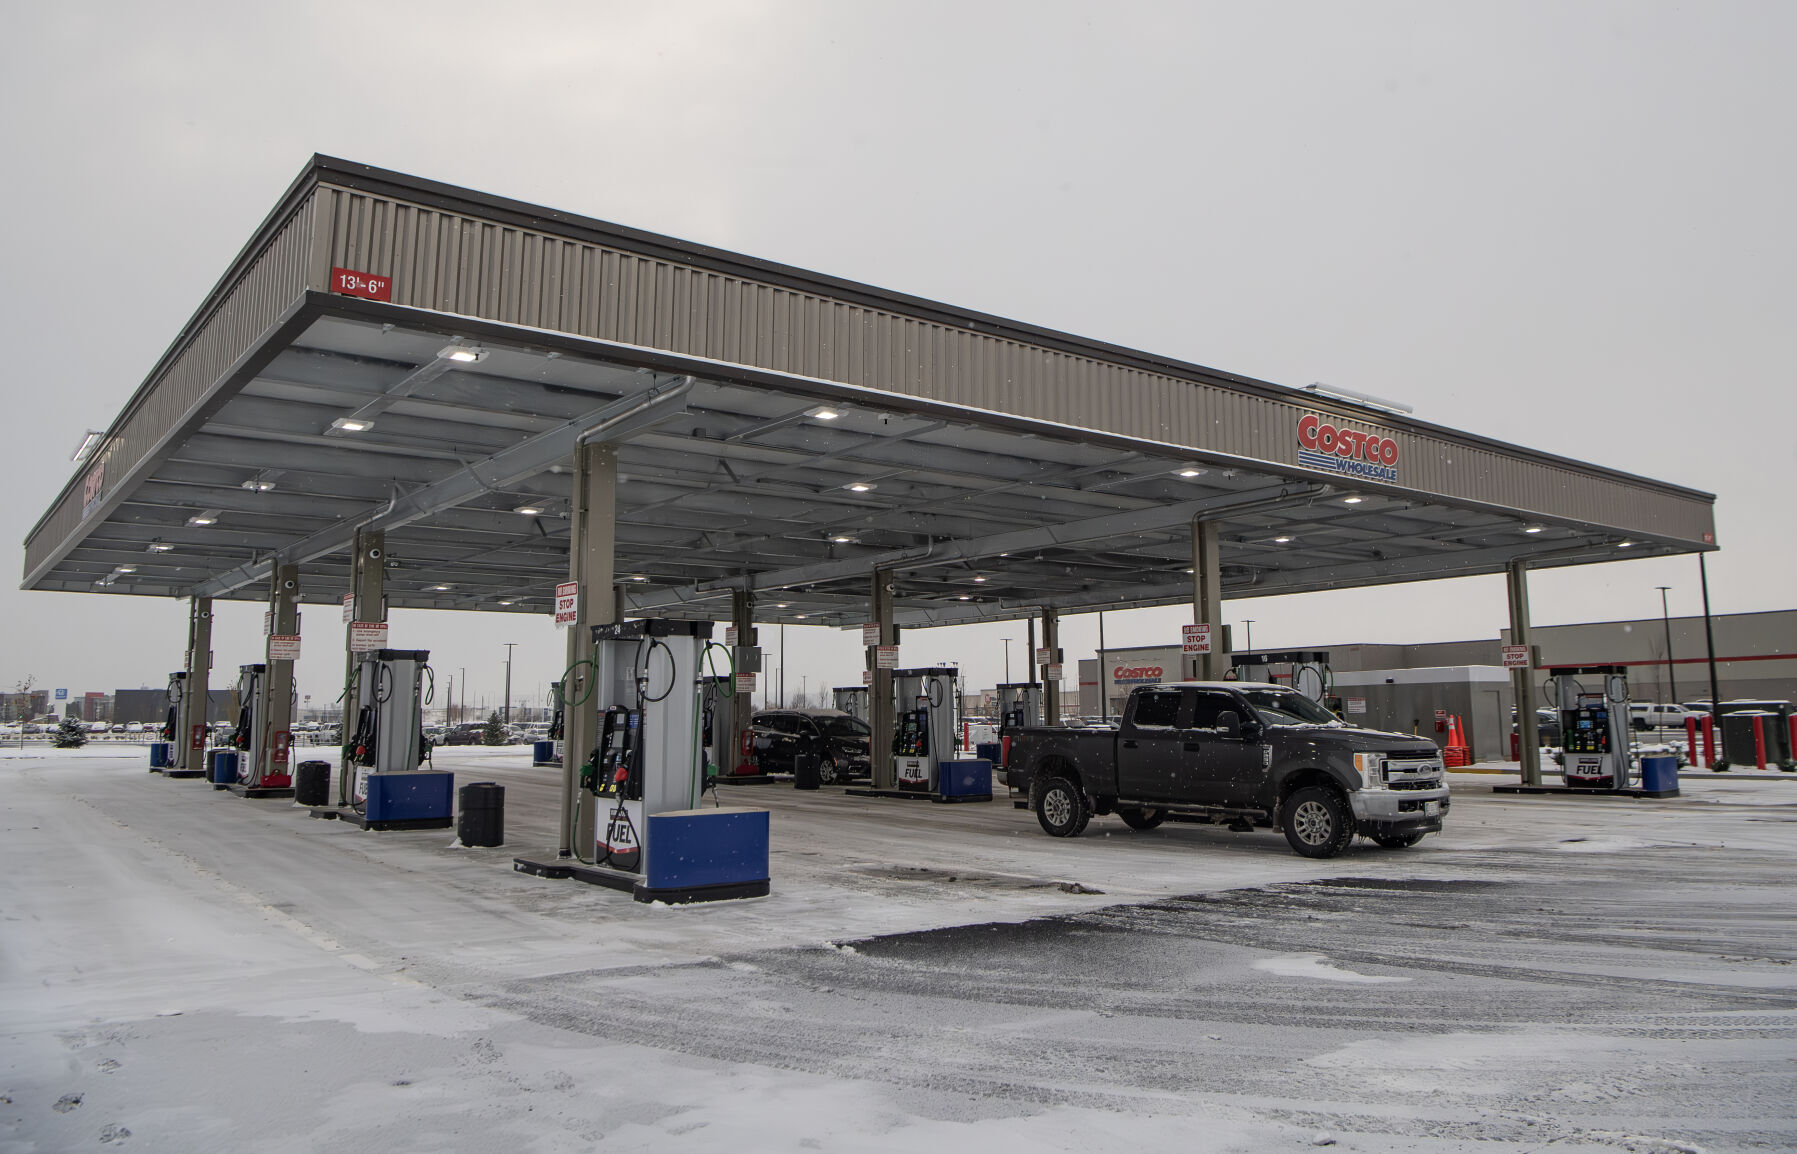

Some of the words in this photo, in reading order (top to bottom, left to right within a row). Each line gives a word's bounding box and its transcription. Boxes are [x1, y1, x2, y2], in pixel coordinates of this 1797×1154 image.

[1297, 414, 1399, 466] COSTCO
[1335, 459, 1397, 481] WHOLESALE
[559, 599, 574, 610] STOP
[556, 611, 577, 623] ENGINE
[1187, 635, 1206, 643] STOP
[1183, 643, 1210, 652] ENGINE
[1503, 659, 1528, 667] ENGINE
[1113, 666, 1163, 679] COSTCO
[1576, 765, 1604, 775] FUEL
